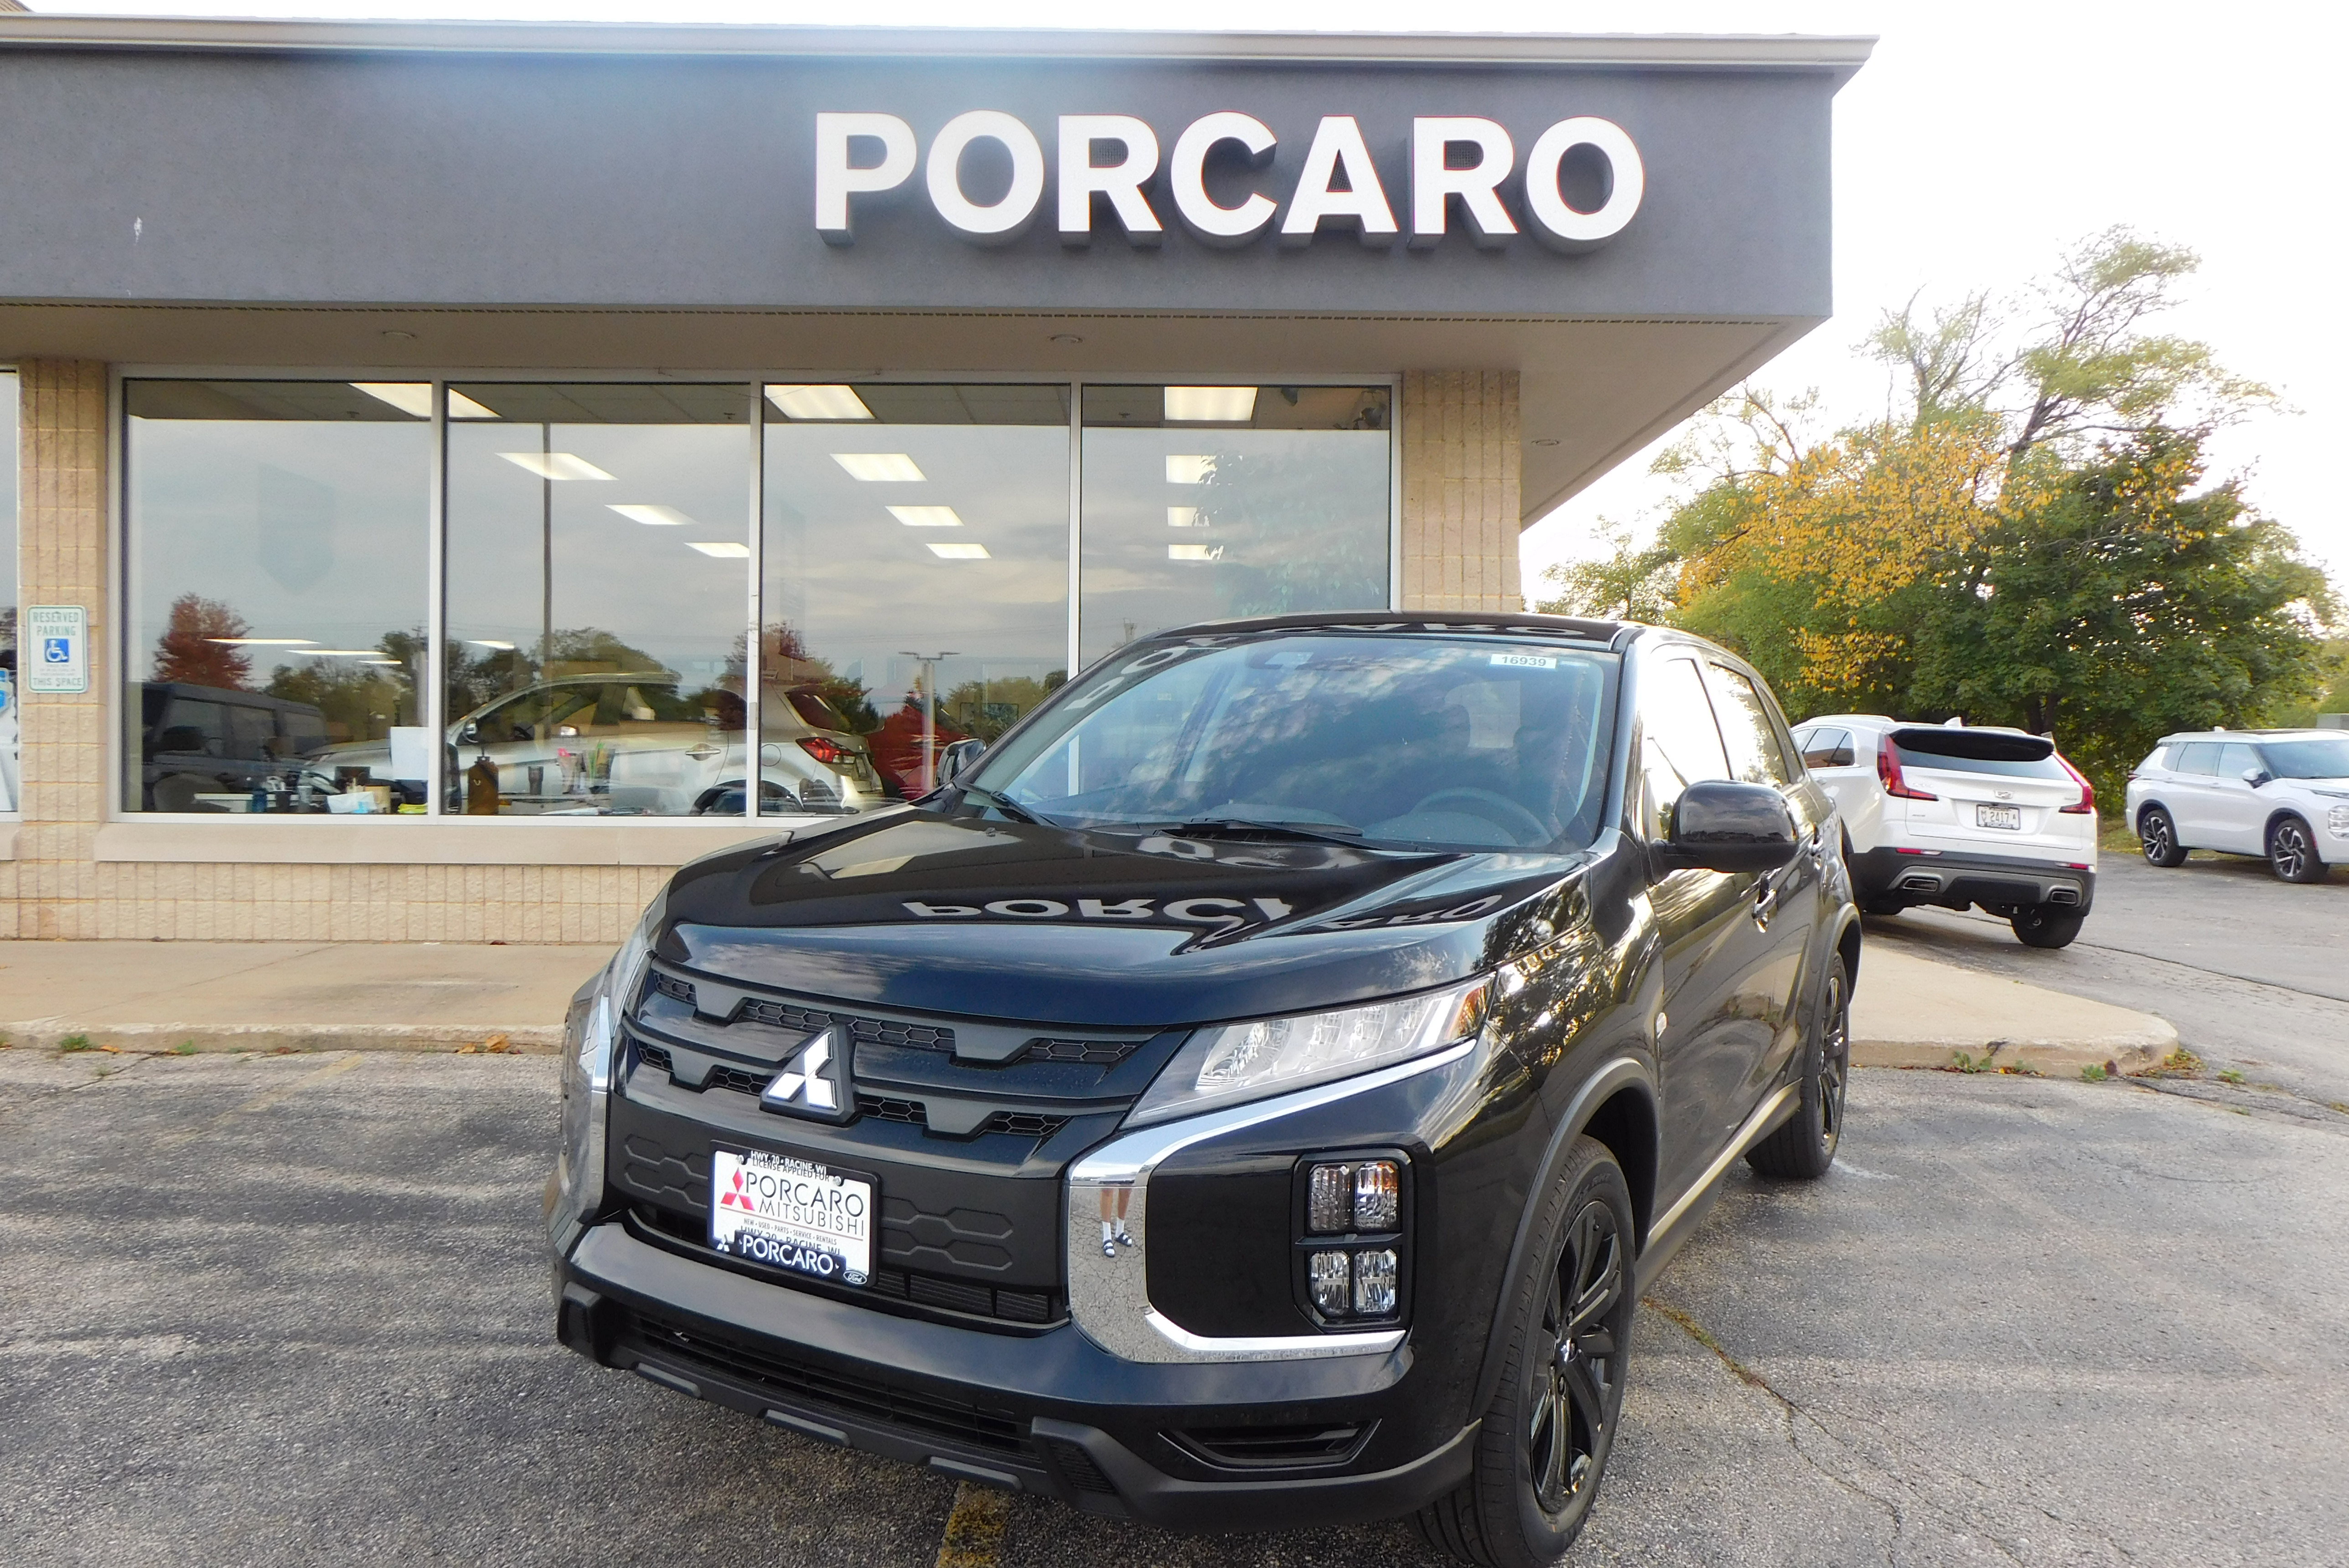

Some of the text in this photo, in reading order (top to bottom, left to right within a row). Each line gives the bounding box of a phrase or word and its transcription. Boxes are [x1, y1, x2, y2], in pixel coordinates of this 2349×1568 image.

[815, 109, 1645, 241] PORCARO
[33, 611, 78, 623] RESERVED
[36, 625, 76, 636] PARKING
[1501, 656, 1547, 666] 16939
[33, 677, 82, 686] THIS SPACE
[1990, 812, 2009, 823] 2417
[752, 1159, 829, 1182] LICENSE APPLIED FOR
[815, 1164, 827, 1175] WI
[746, 1171, 864, 1217] PORCARO
[759, 1197, 864, 1236] MITSUBISHI
[744, 1217, 837, 1245] NEW USED PARTS SERVICE RENTALS
[742, 1234, 833, 1274] PORCARO
